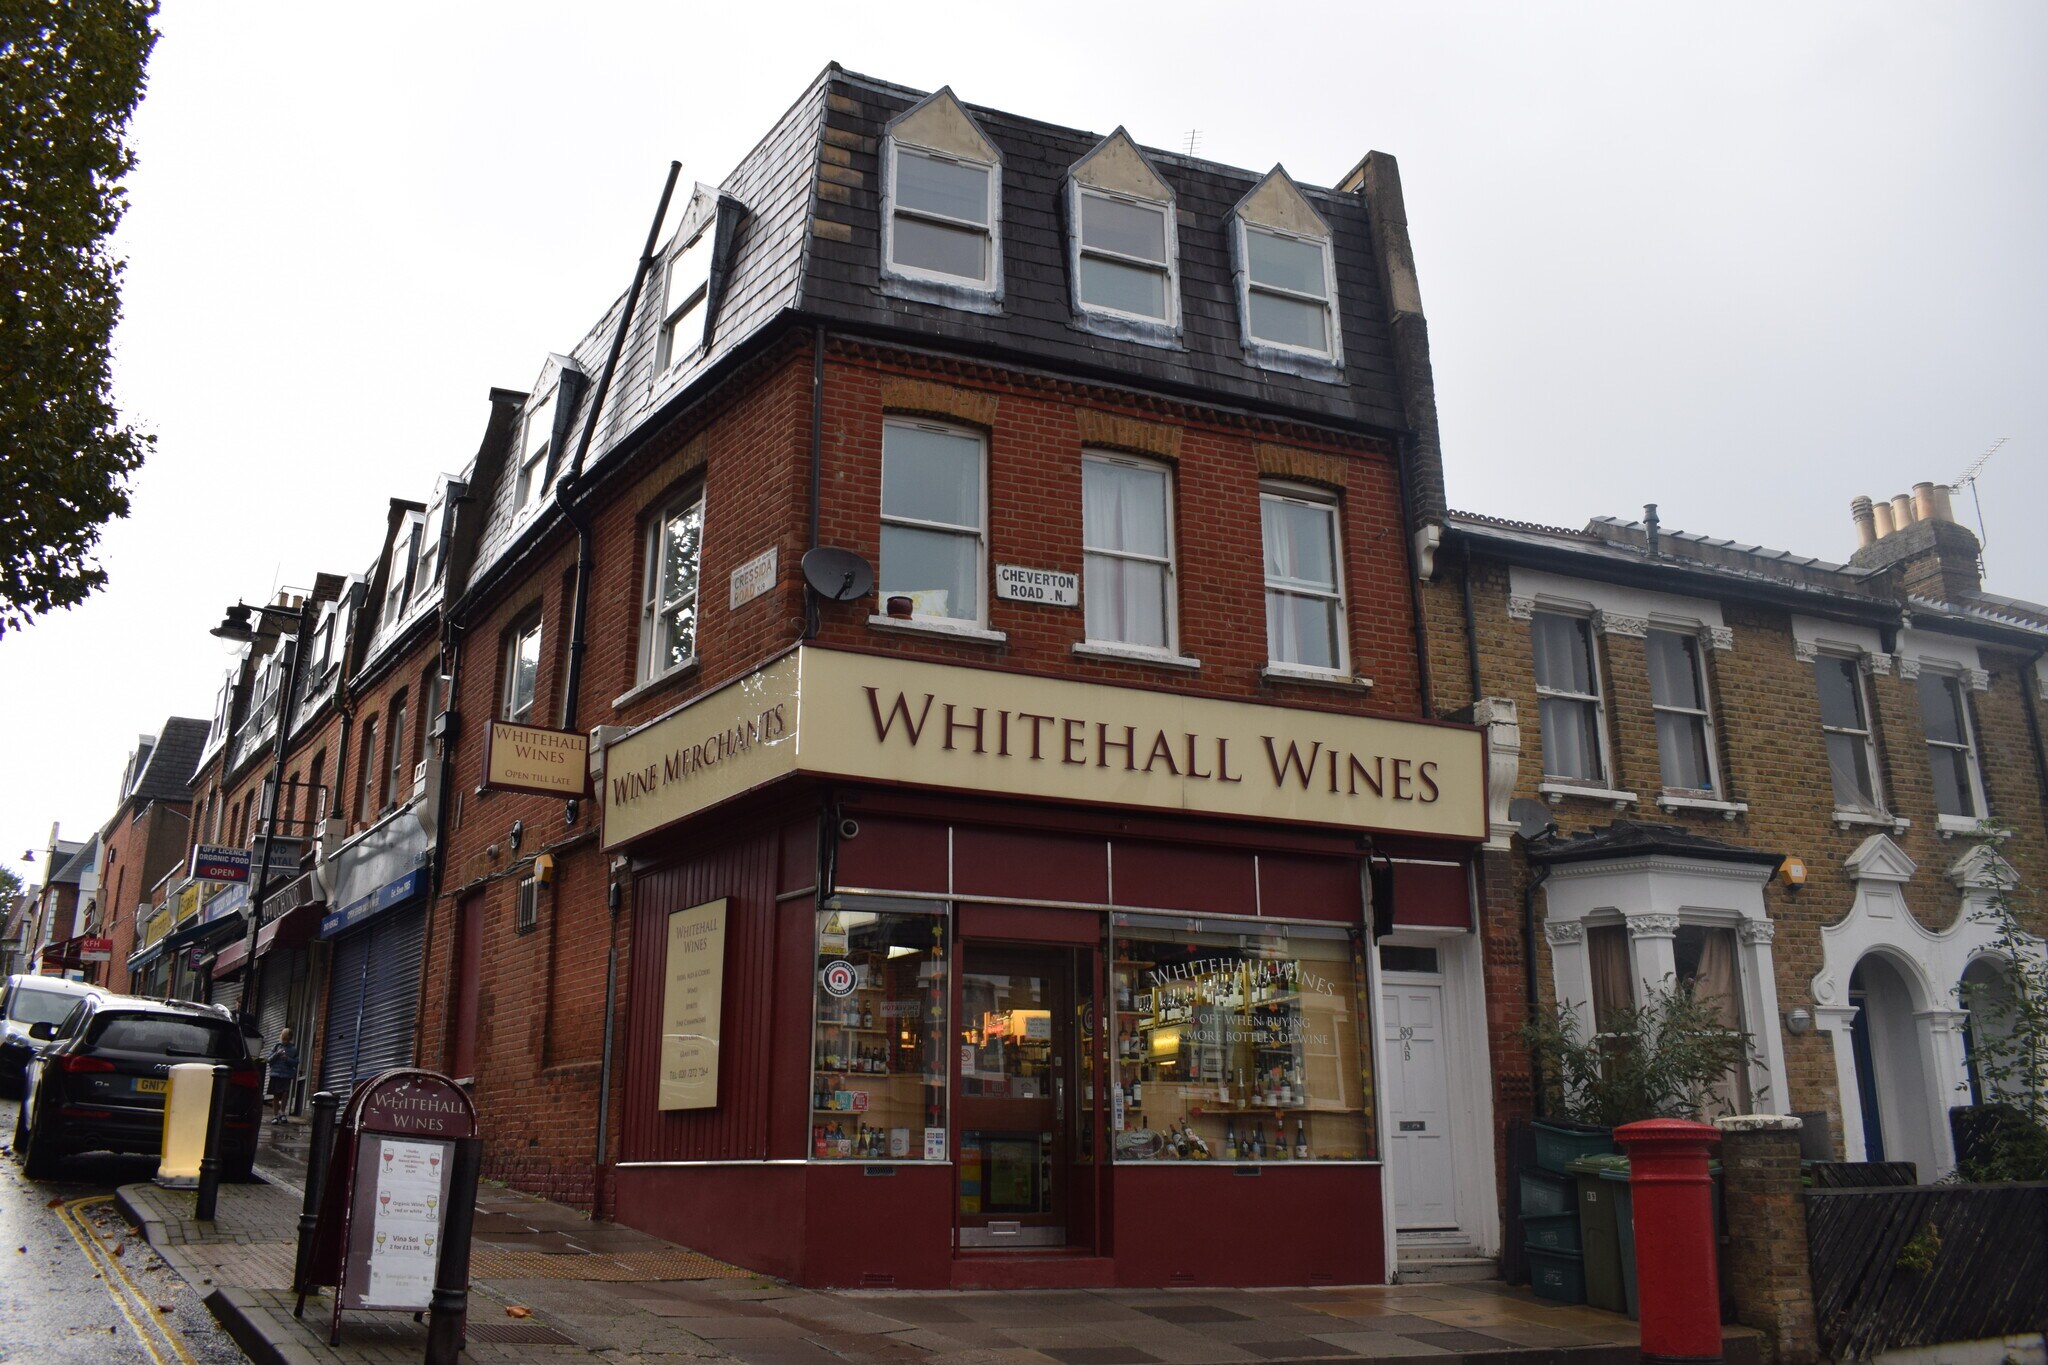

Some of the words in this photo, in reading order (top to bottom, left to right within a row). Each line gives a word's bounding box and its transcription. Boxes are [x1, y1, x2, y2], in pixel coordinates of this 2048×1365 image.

[734, 559, 772, 589] CRESSIDA
[1002, 569, 1074, 589] CHEVERTON
[735, 583, 756, 606] ROAD
[1011, 585, 1044, 599] ROAD
[495, 726, 585, 752] WHITEHALL
[862, 686, 1242, 783] WHITEHALL
[1261, 735, 1439, 803] WINES
[515, 745, 565, 764] WINES
[612, 763, 657, 806] WINE
[663, 703, 785, 786] MERCHANTS
[505, 769, 529, 780] OPEN
[532, 774, 548, 783] TILL
[552, 776, 571, 785] LATE
[198, 853, 229, 863] ORGANIC
[230, 856, 249, 864] FOOD
[218, 847, 247, 856] LICENCE
[258, 855, 293, 866] RNTAL
[209, 867, 235, 877] OPEN
[676, 918, 717, 939] WHITEHALL
[684, 938, 708, 953] WINES
[1149, 957, 1267, 987] WHITEHALL
[1275, 959, 1335, 998] WINES
[1199, 1014, 1221, 1025] OFF
[1225, 1015, 1263, 1026] WHEN
[1267, 1016, 1311, 1028] BUYING
[1187, 1031, 1221, 1042] MORE
[1226, 1031, 1275, 1043] BOTTLES
[1279, 1032, 1295, 1044] OF
[1299, 1034, 1328, 1045] WINE
[1400, 1026, 1413, 1040] 89
[1404, 1040, 1411, 1051] A
[1404, 1050, 1411, 1061] B
[141, 1080, 167, 1091] GN17
[375, 1093, 466, 1114] WHITEHALL
[393, 1114, 444, 1130] WINES
